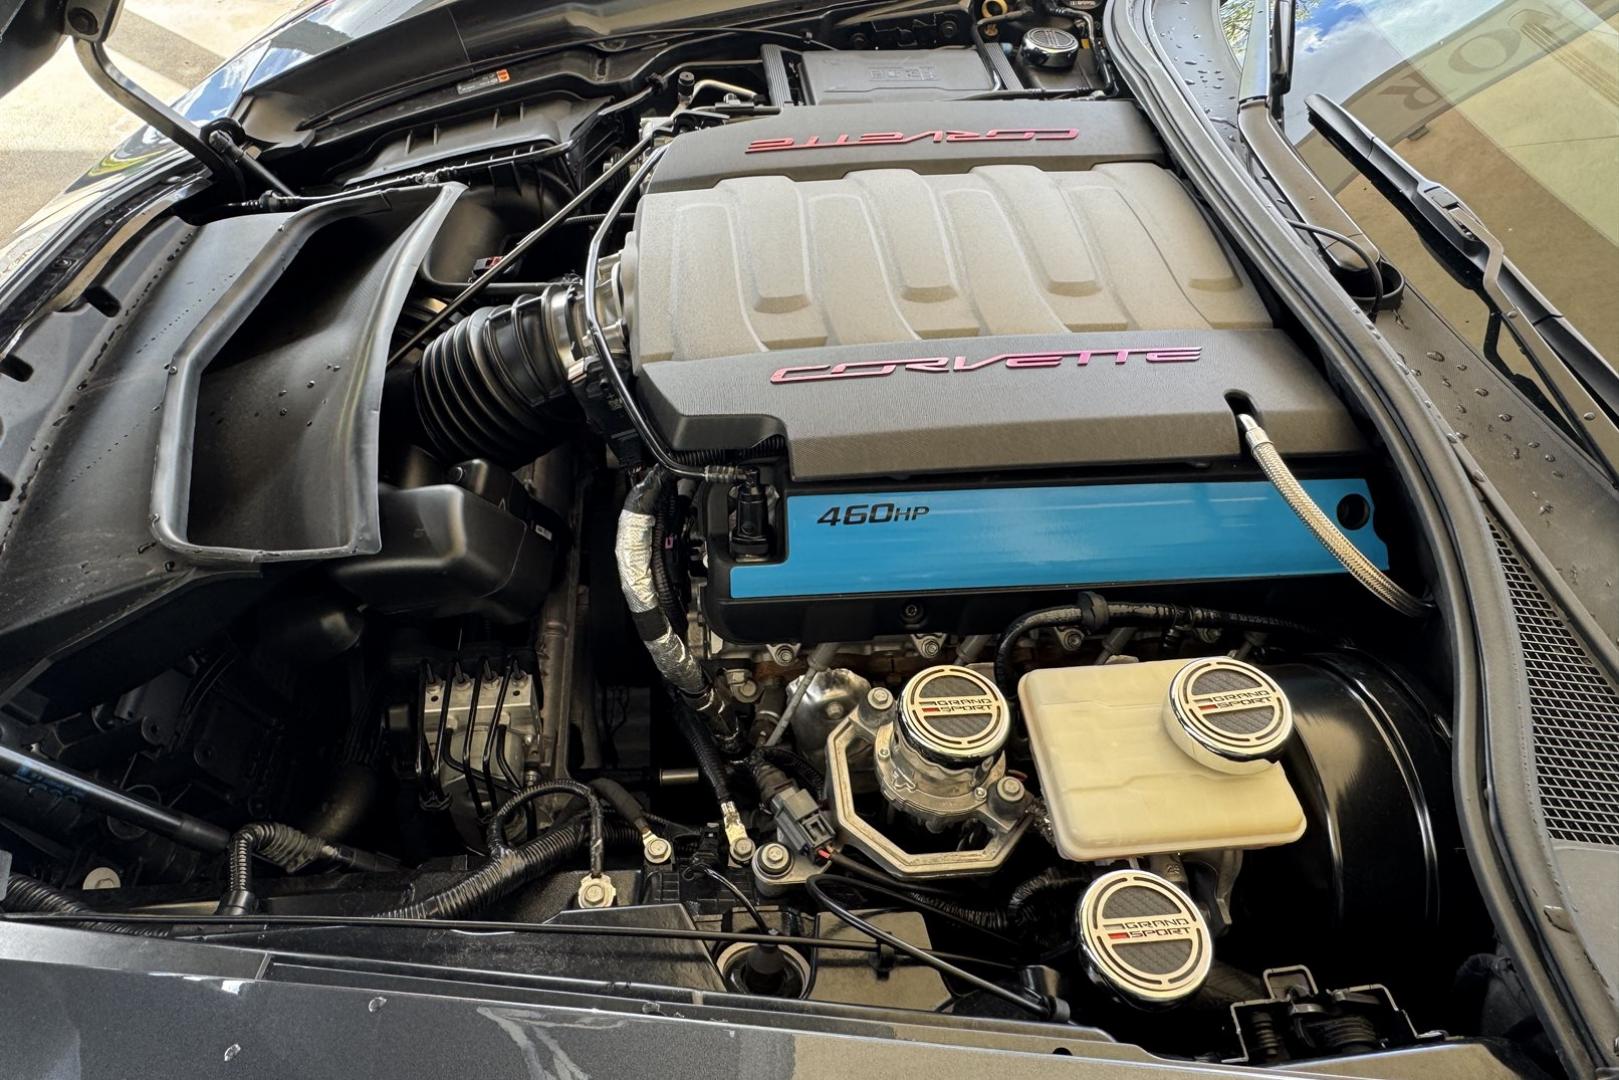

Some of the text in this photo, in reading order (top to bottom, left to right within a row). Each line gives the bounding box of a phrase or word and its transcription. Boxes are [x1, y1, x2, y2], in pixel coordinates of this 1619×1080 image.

[745, 128, 1080, 154] CORVETTE
[770, 346, 1202, 384] CORVETTE
[816, 503, 930, 527] 460HP
[937, 698, 992, 706] GRAND
[1212, 690, 1270, 702] GRAND
[940, 704, 993, 713] SPORT
[1217, 696, 1272, 709] SPORT
[1124, 918, 1189, 930] GRAND
[1129, 927, 1191, 938] SPORT
